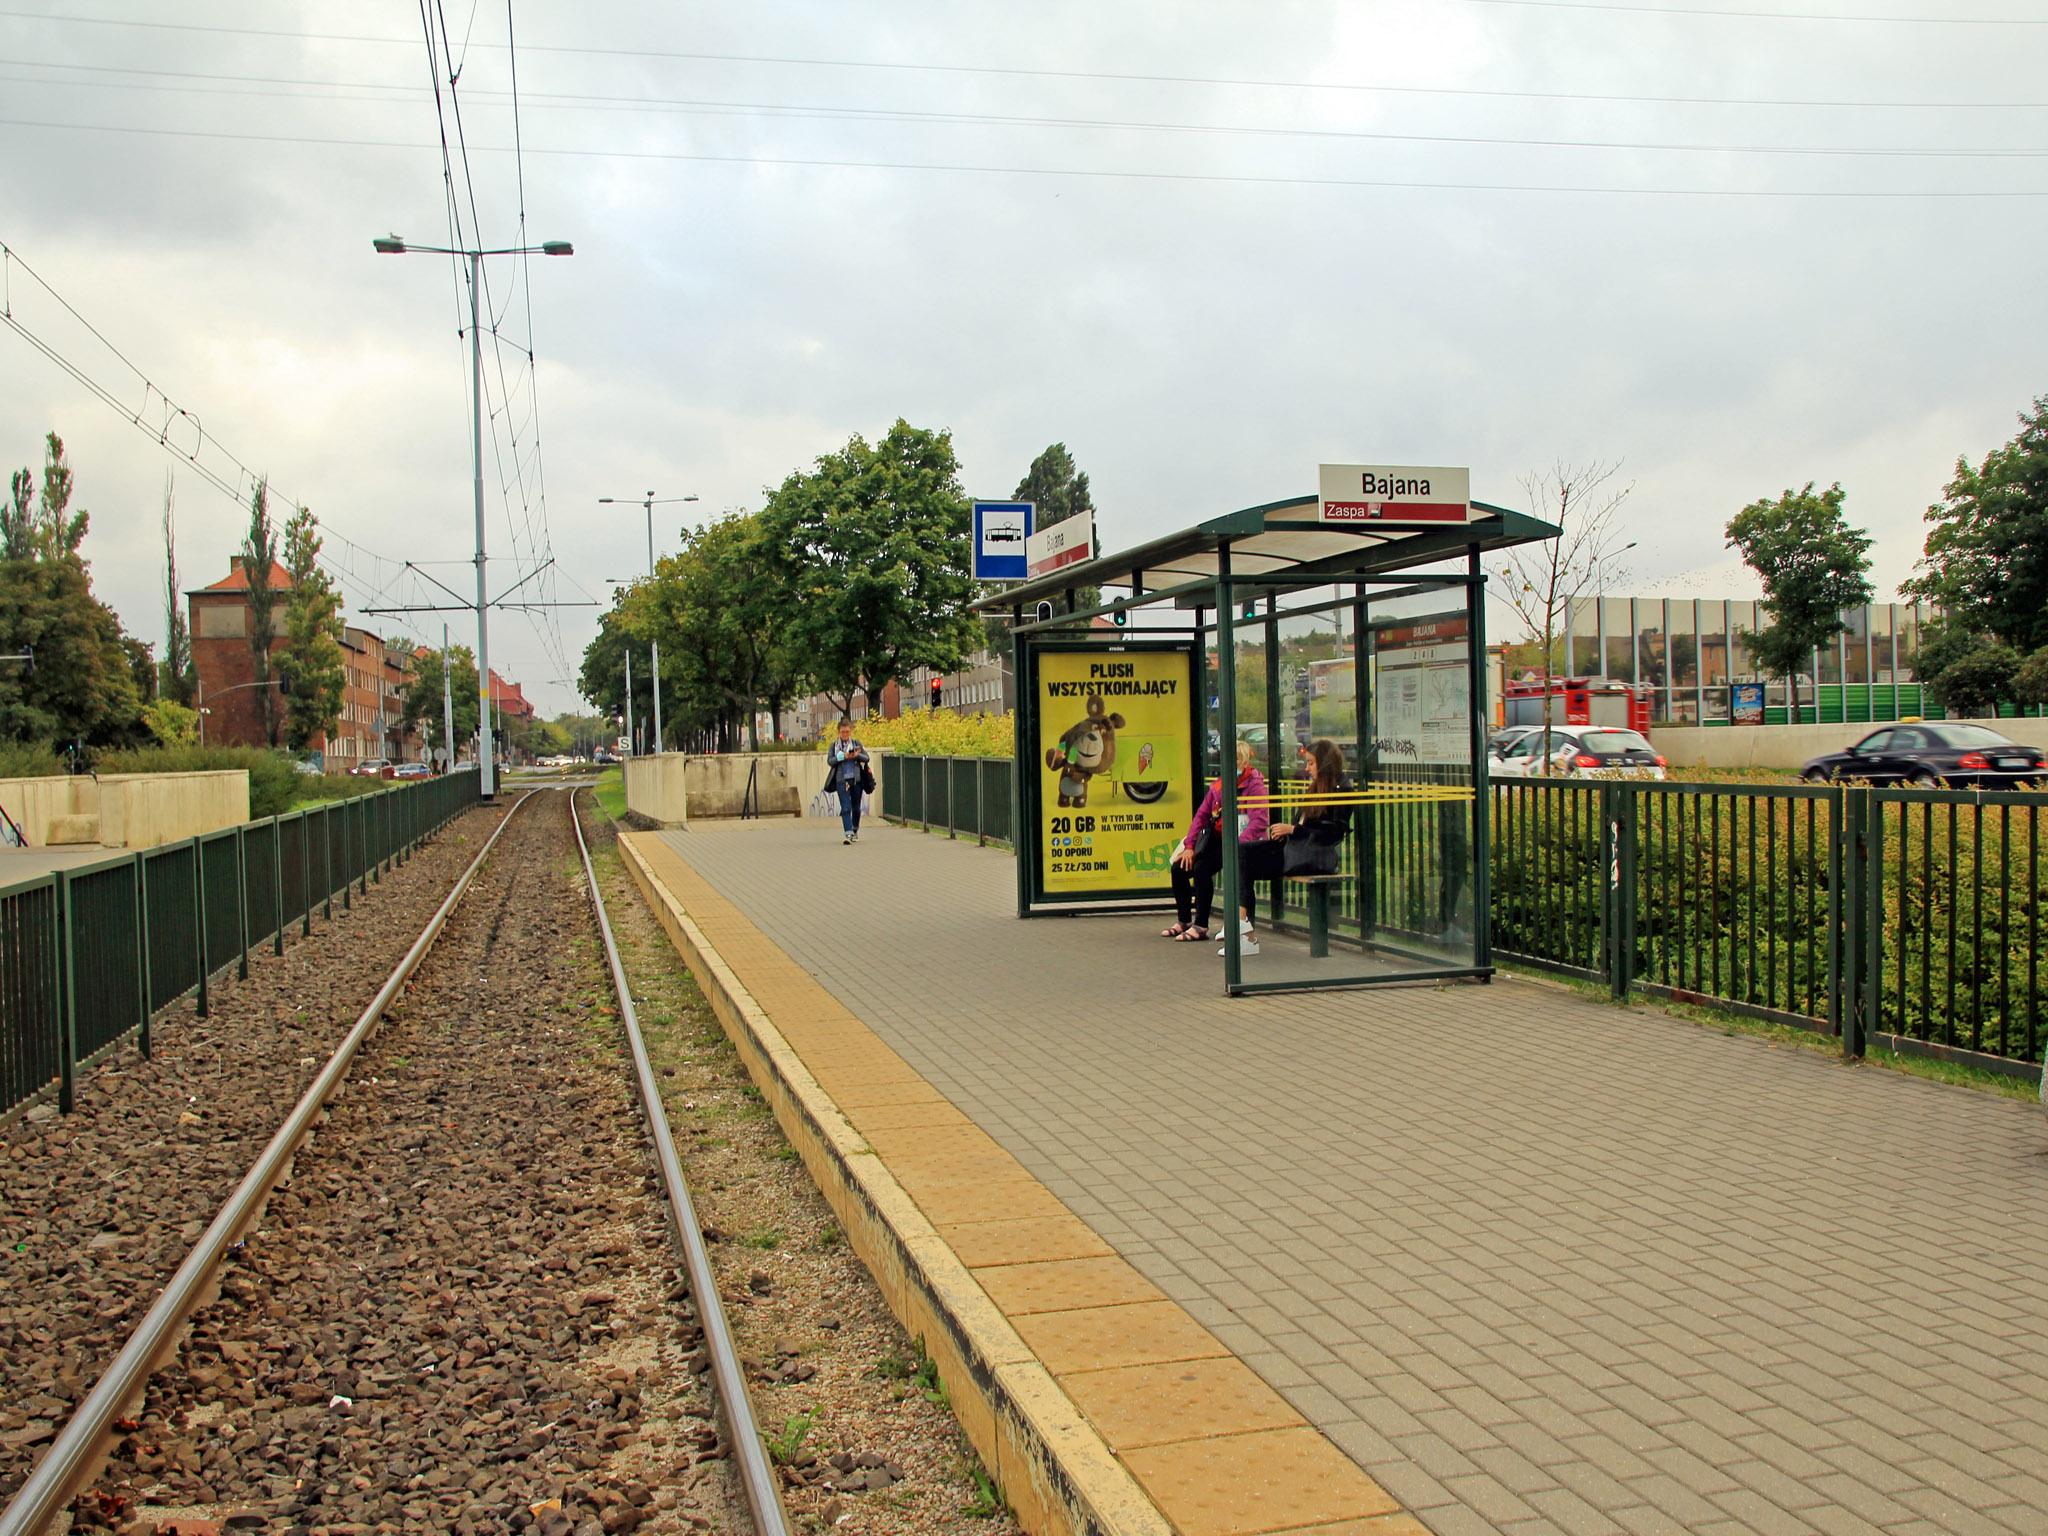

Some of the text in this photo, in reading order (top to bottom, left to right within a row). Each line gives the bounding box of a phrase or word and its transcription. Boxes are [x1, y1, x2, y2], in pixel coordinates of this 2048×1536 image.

[1362, 473, 1431, 500] Bajana
[1327, 504, 1365, 519] Zaspa
[1413, 624, 1436, 637] BAJANA
[1090, 663, 1134, 678] PLUSH
[1048, 680, 1177, 698] WSZYSTKOMAJĄCY
[620, 738, 630, 749] S
[1051, 815, 1095, 834] 20 GB
[1101, 815, 1108, 823] W
[1126, 814, 1133, 822] 10
[1134, 814, 1144, 822] GB
[1101, 824, 1111, 832] NA
[1113, 823, 1143, 831] YOUTUBE
[1150, 822, 1175, 830] TIKTOK
[1051, 847, 1093, 858] DO OPORU
[1051, 863, 1063, 872] 25
[1094, 861, 1109, 871] DNI
